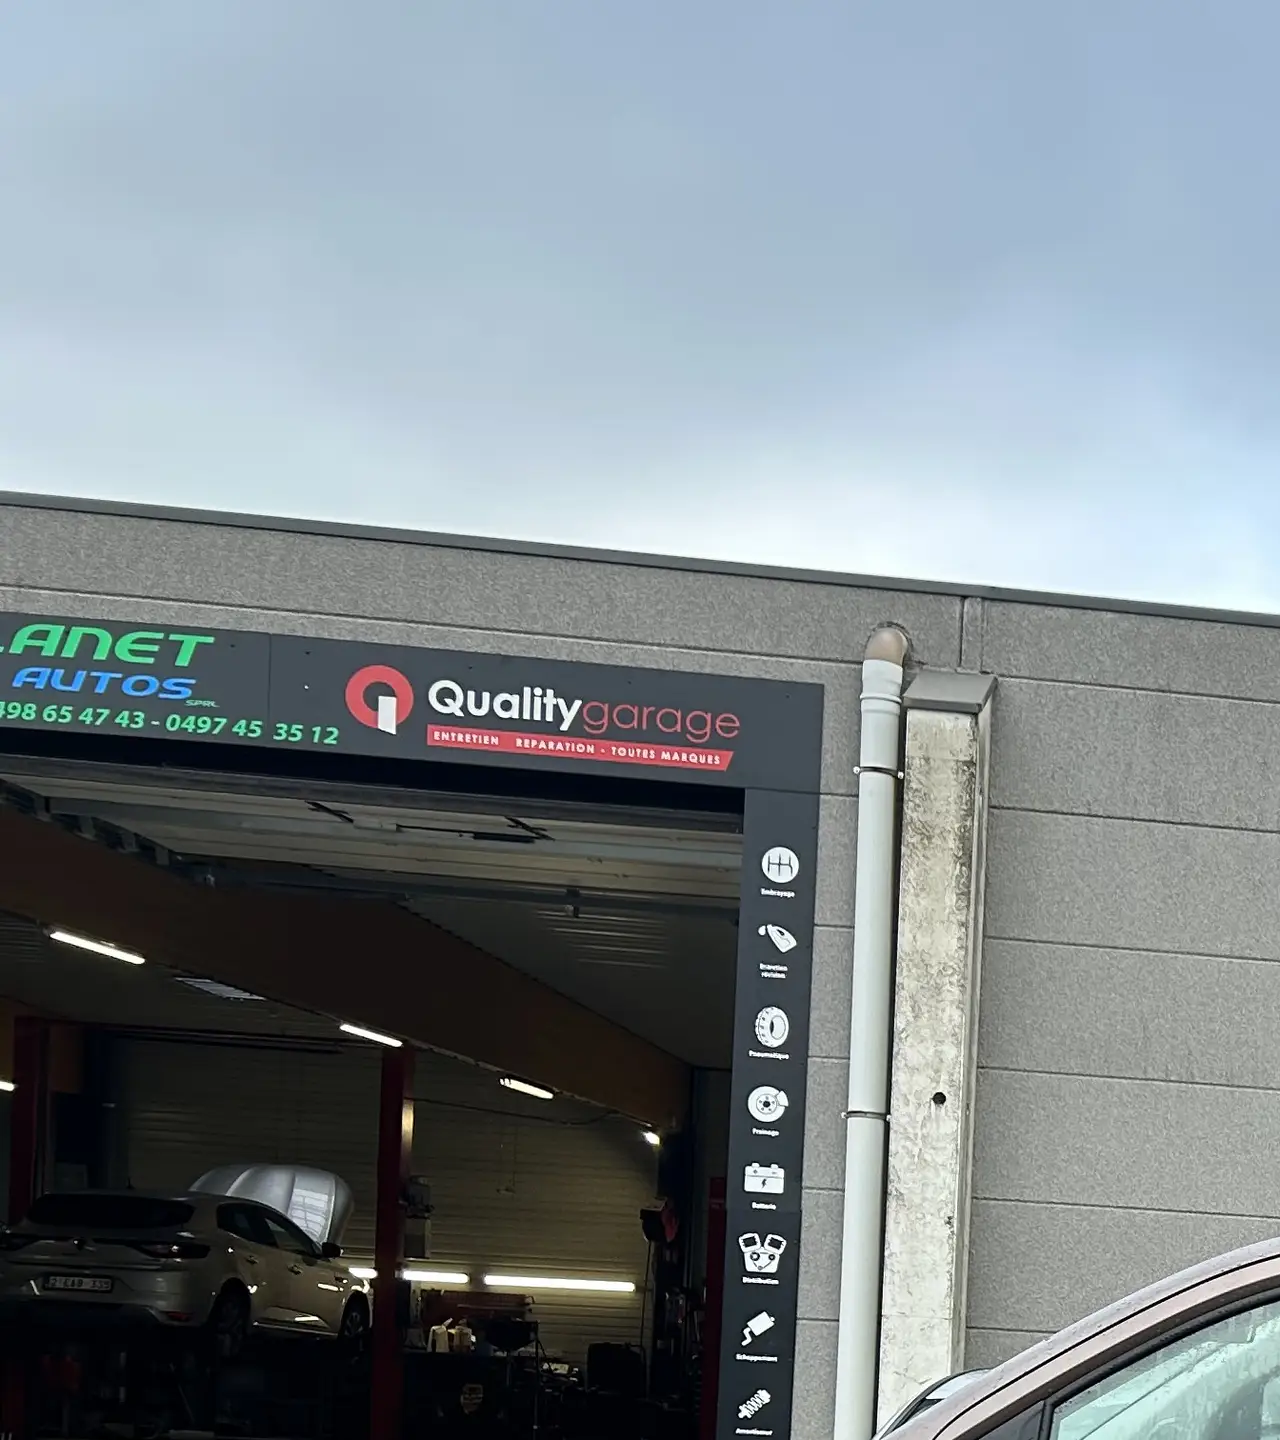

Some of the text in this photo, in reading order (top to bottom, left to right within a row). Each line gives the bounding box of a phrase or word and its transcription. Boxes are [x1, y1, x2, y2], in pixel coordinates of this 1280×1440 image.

[0, 623, 215, 667] ANET
[11, 666, 197, 700] AUTOS
[42, 704, 73, 724] 65
[78, 707, 110, 726] 47
[114, 710, 145, 729] 43
[165, 713, 227, 735] 0497
[232, 718, 263, 738] 45
[273, 723, 304, 743] 35
[311, 726, 339, 745] 12
[433, 730, 500, 747] ENTRETIEN
[611, 745, 656, 760] TOUTES
[660, 750, 721, 766] MARQUES
